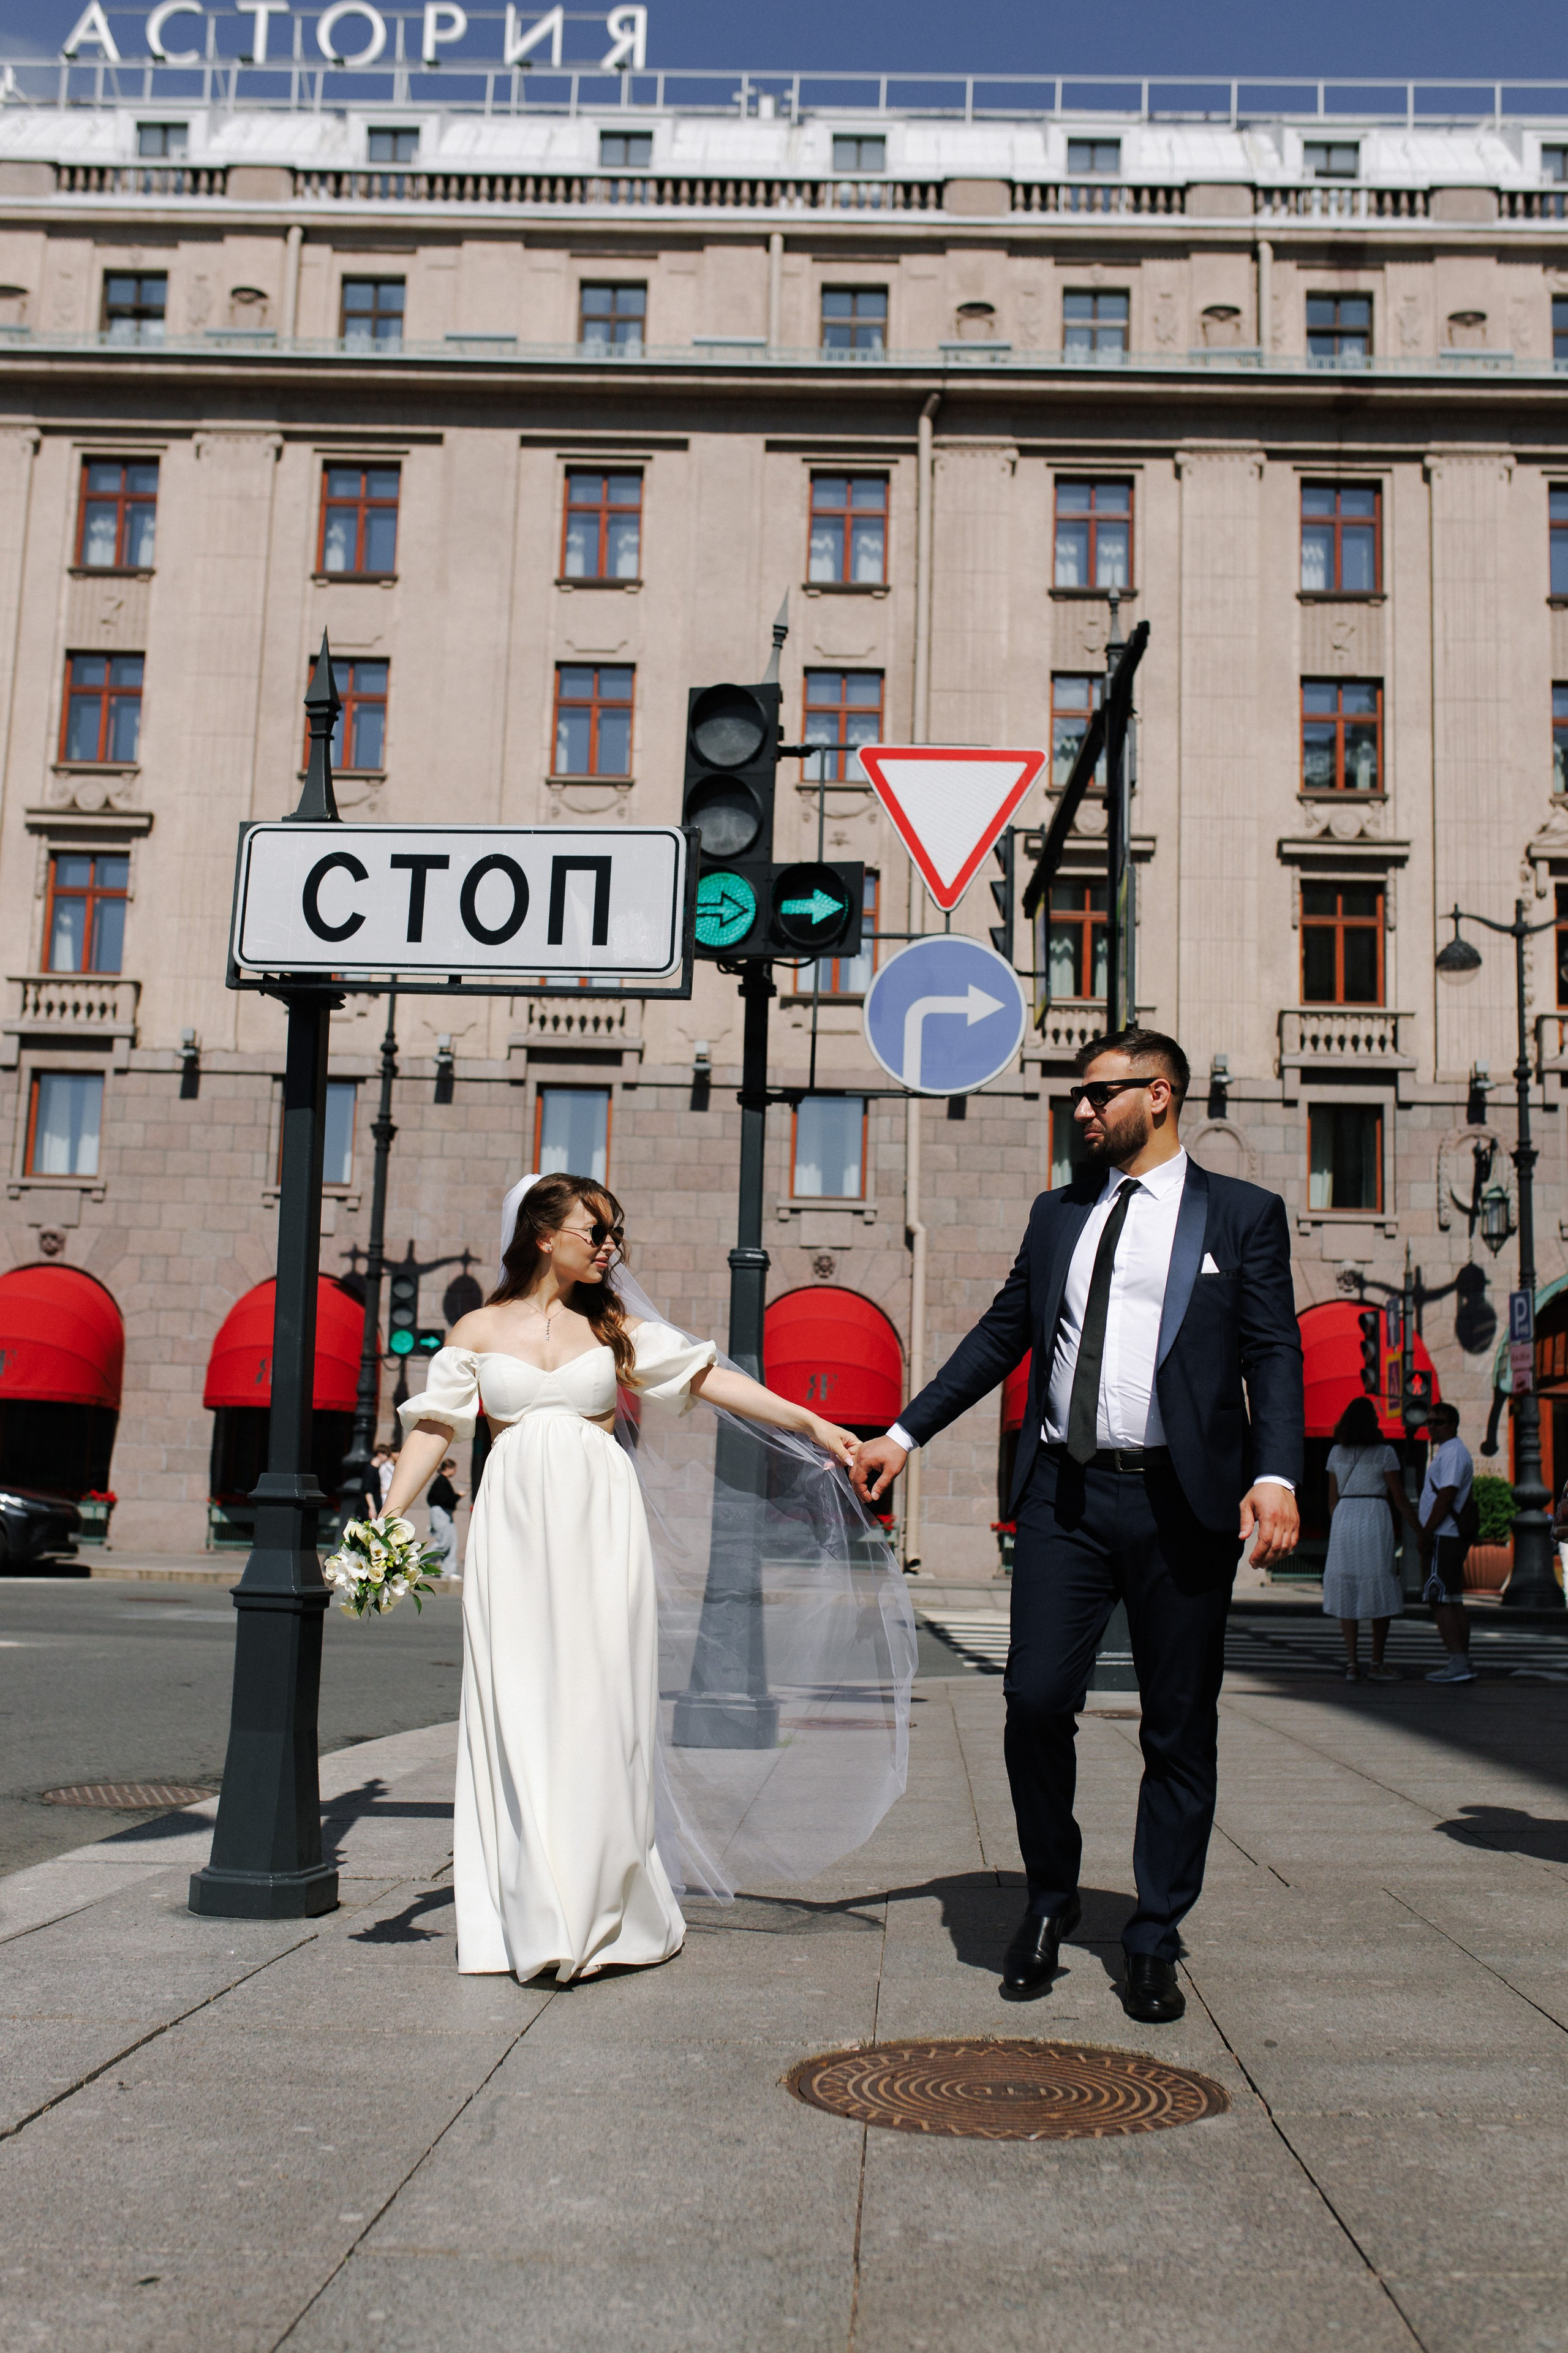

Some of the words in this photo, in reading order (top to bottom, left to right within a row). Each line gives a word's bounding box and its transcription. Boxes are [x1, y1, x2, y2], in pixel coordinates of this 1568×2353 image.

[62, 0, 647, 70] АСТОРИЯ
[303, 852, 612, 946] СТОП
[1515, 1297, 1527, 1336] P
